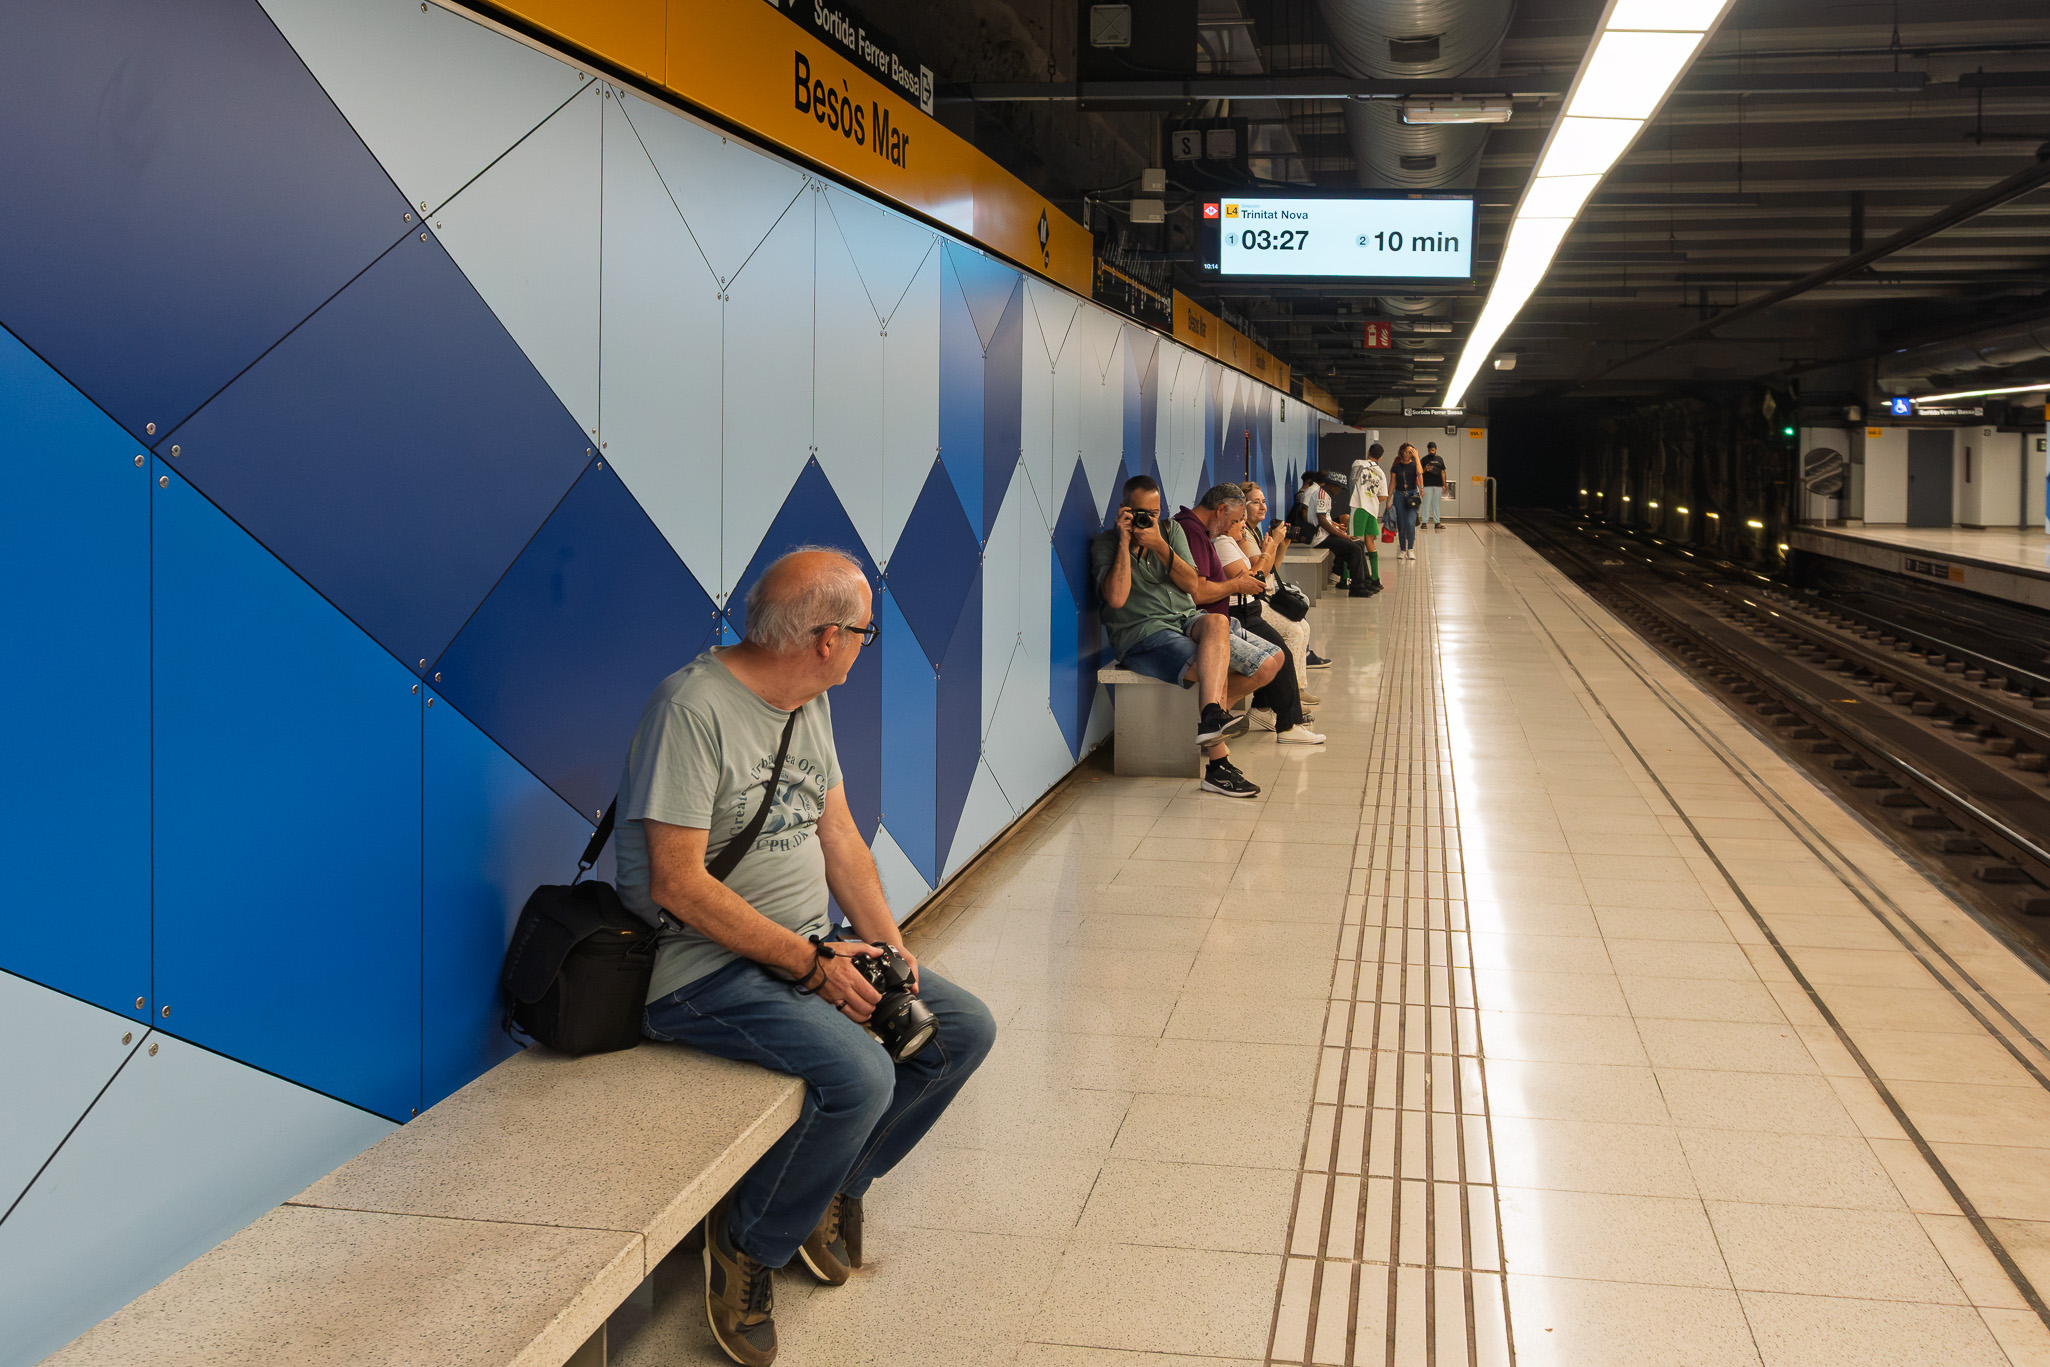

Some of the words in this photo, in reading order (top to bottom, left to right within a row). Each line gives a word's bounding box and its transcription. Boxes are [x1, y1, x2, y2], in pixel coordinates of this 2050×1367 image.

[814, 0, 855, 50] Sortida
[858, 28, 890, 74] Ferrer
[892, 53, 919, 97] Bassa
[795, 50, 865, 146] Besòs
[872, 101, 909, 169] Mar
[1226, 206, 1238, 215] L4
[1241, 209, 1278, 220] Trinitat
[1281, 210, 1309, 220] Nova
[1229, 235, 1234, 244] 1
[1241, 229, 1309, 251] 03:27
[1359, 236, 1366, 245] 2
[1374, 231, 1403, 252] 10
[1411, 231, 1459, 252] min
[798, 758, 816, 775] Of
